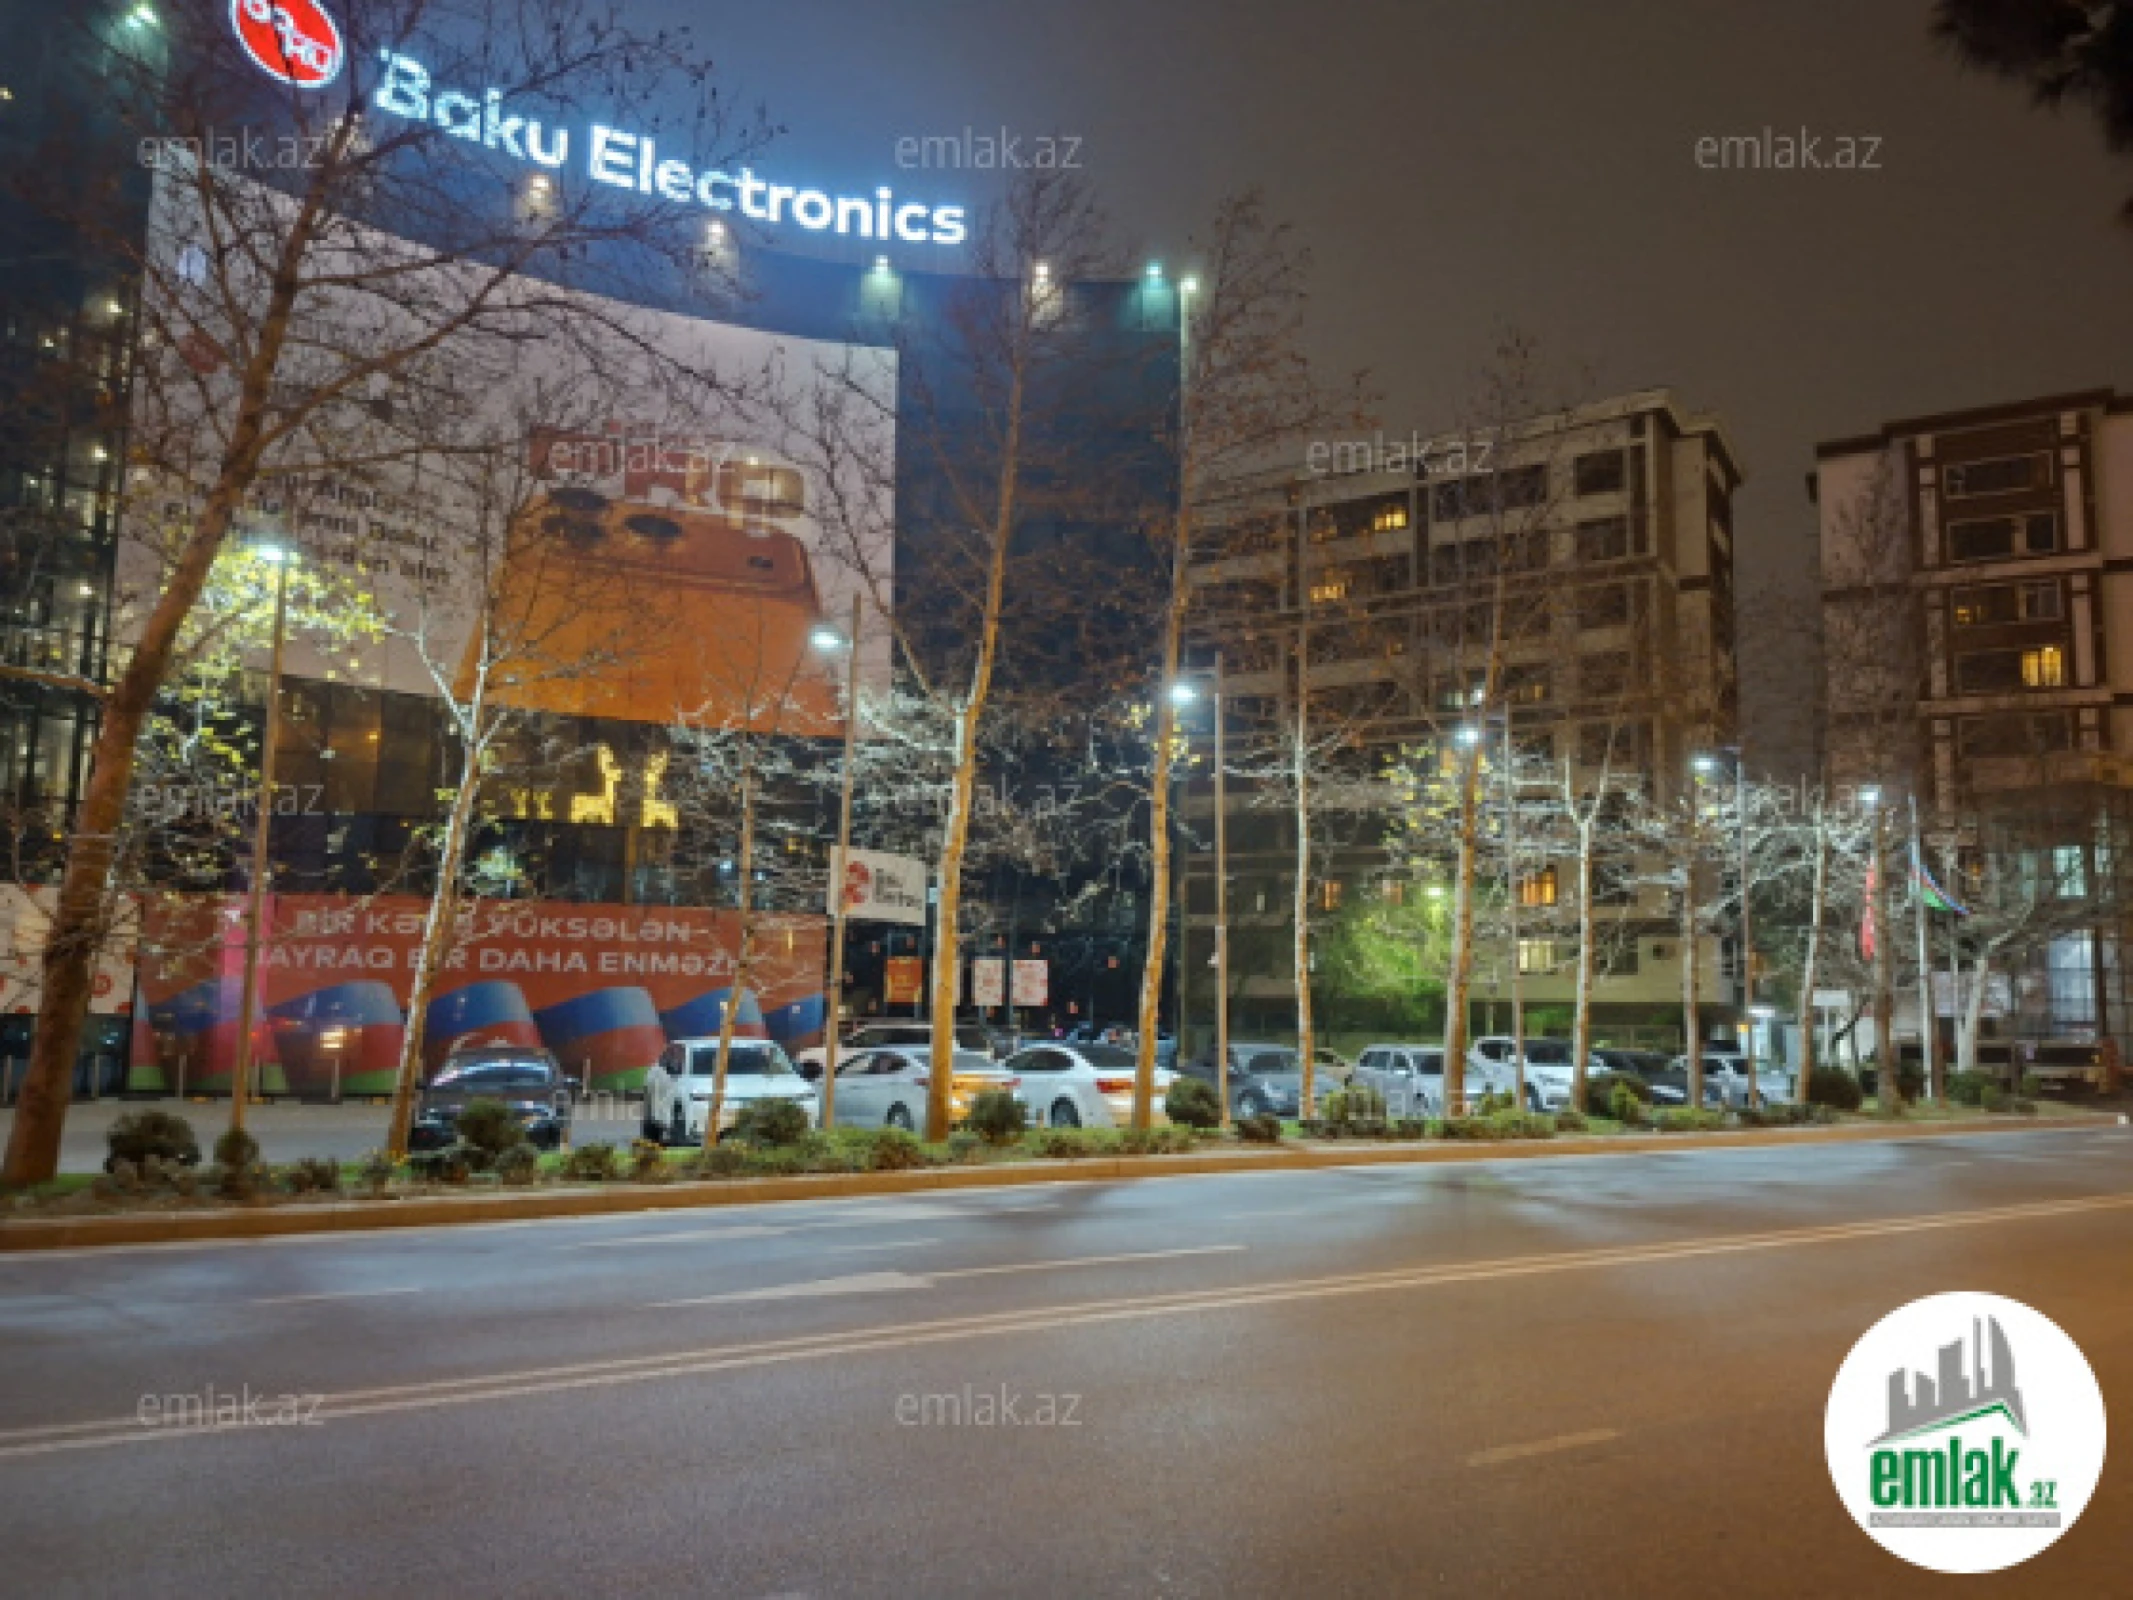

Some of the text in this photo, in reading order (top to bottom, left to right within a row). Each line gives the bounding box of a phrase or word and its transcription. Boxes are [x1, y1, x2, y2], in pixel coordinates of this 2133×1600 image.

[373, 52, 967, 244] Baku Electronics
[366, 912, 477, 937] KƏƏ
[407, 947, 467, 971] BR
[478, 948, 589, 973] DAHA
